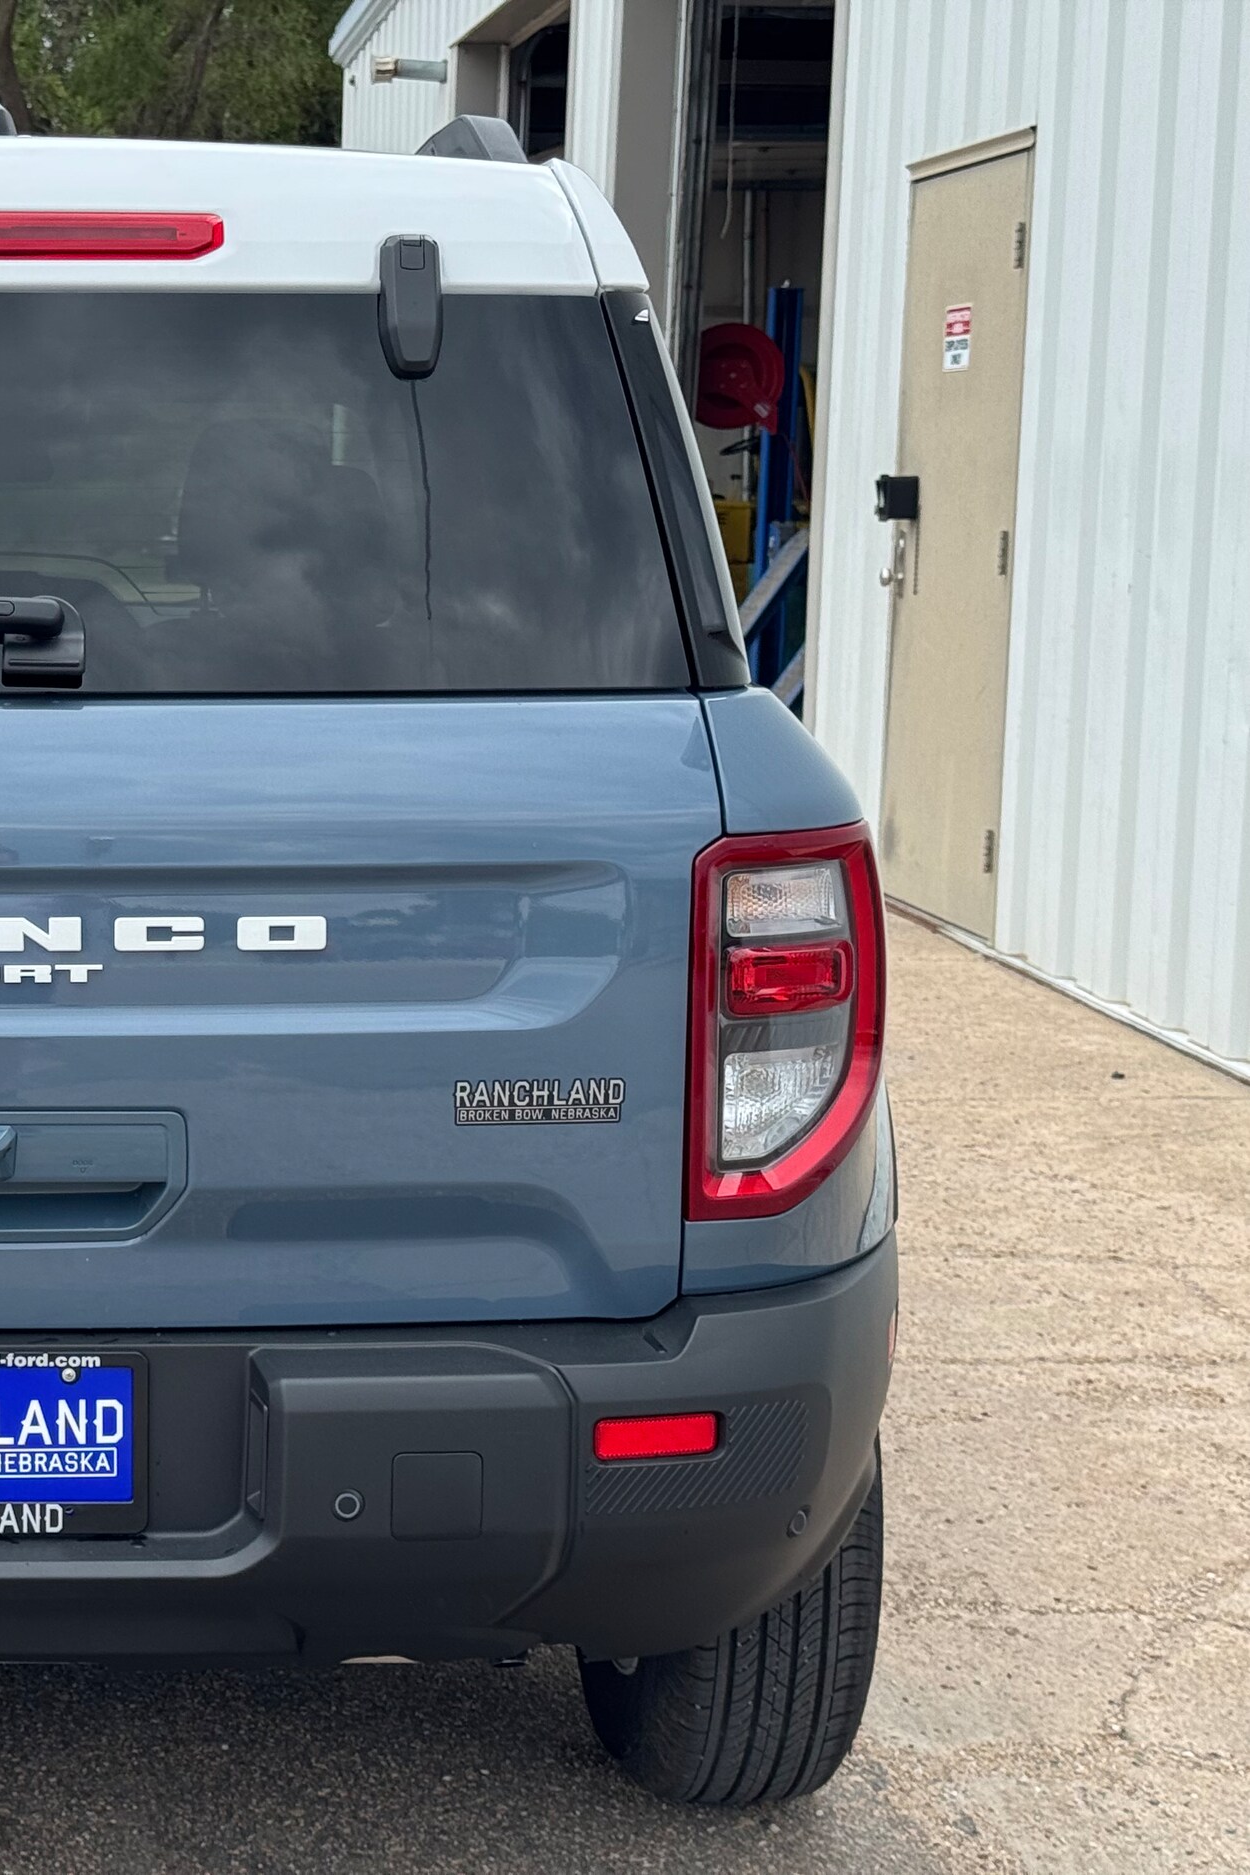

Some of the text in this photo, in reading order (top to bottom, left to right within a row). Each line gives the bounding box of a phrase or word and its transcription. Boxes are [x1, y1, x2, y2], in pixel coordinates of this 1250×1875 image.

[455, 1079, 625, 1107] RANCHLAND
[459, 1109, 509, 1121] BROKEN
[551, 1107, 616, 1119] NEBRASKA
